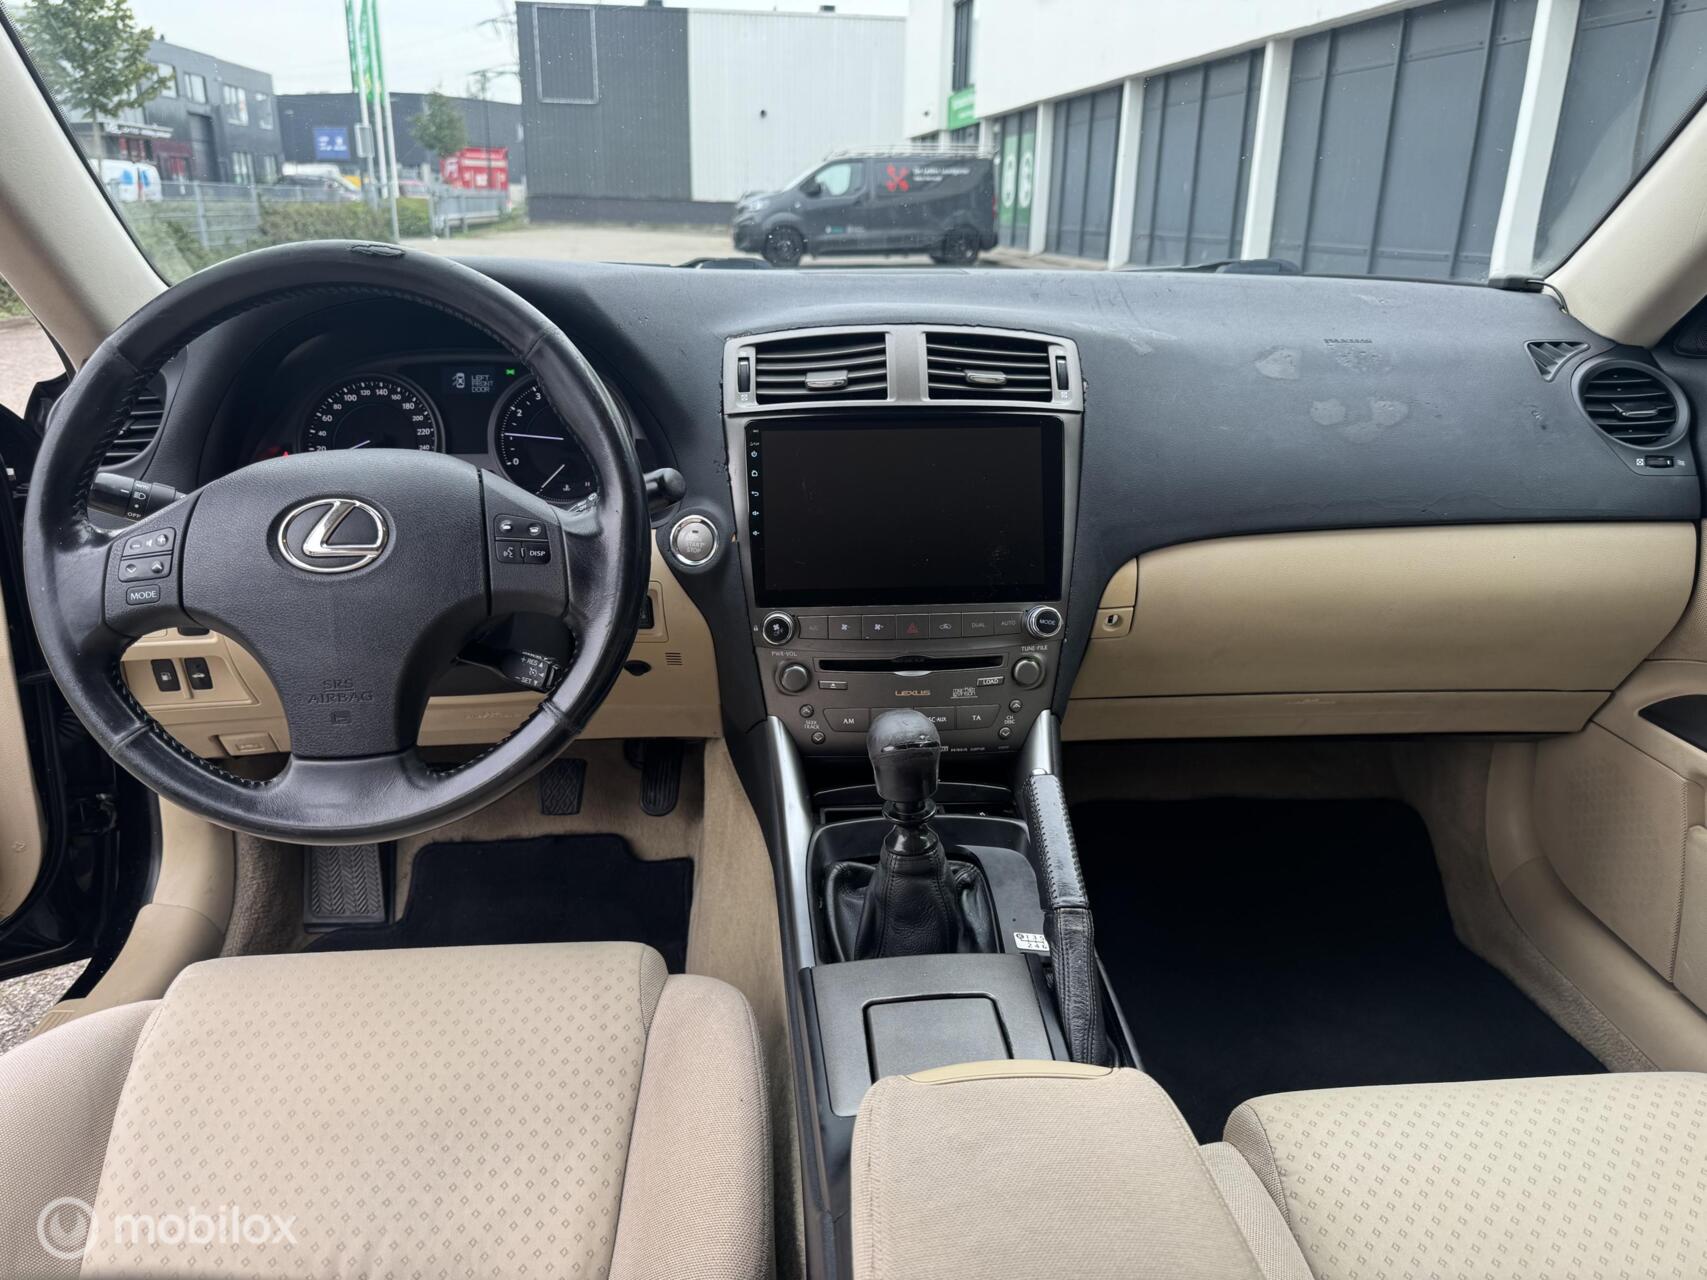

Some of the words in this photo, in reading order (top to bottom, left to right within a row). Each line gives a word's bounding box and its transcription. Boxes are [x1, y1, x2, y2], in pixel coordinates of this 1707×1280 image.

[375, 388, 388, 396] 140
[535, 392, 541, 400] 3
[402, 402, 415, 410] 180
[516, 409, 522, 417] 2
[322, 414, 332, 422] 60
[417, 428, 430, 436] 220
[130, 590, 157, 601] MODE
[1039, 618, 1056, 626] MODE
[322, 679, 354, 690] SRS
[308, 690, 374, 704] AIRBAG
[895, 689, 932, 697] LEXUS
